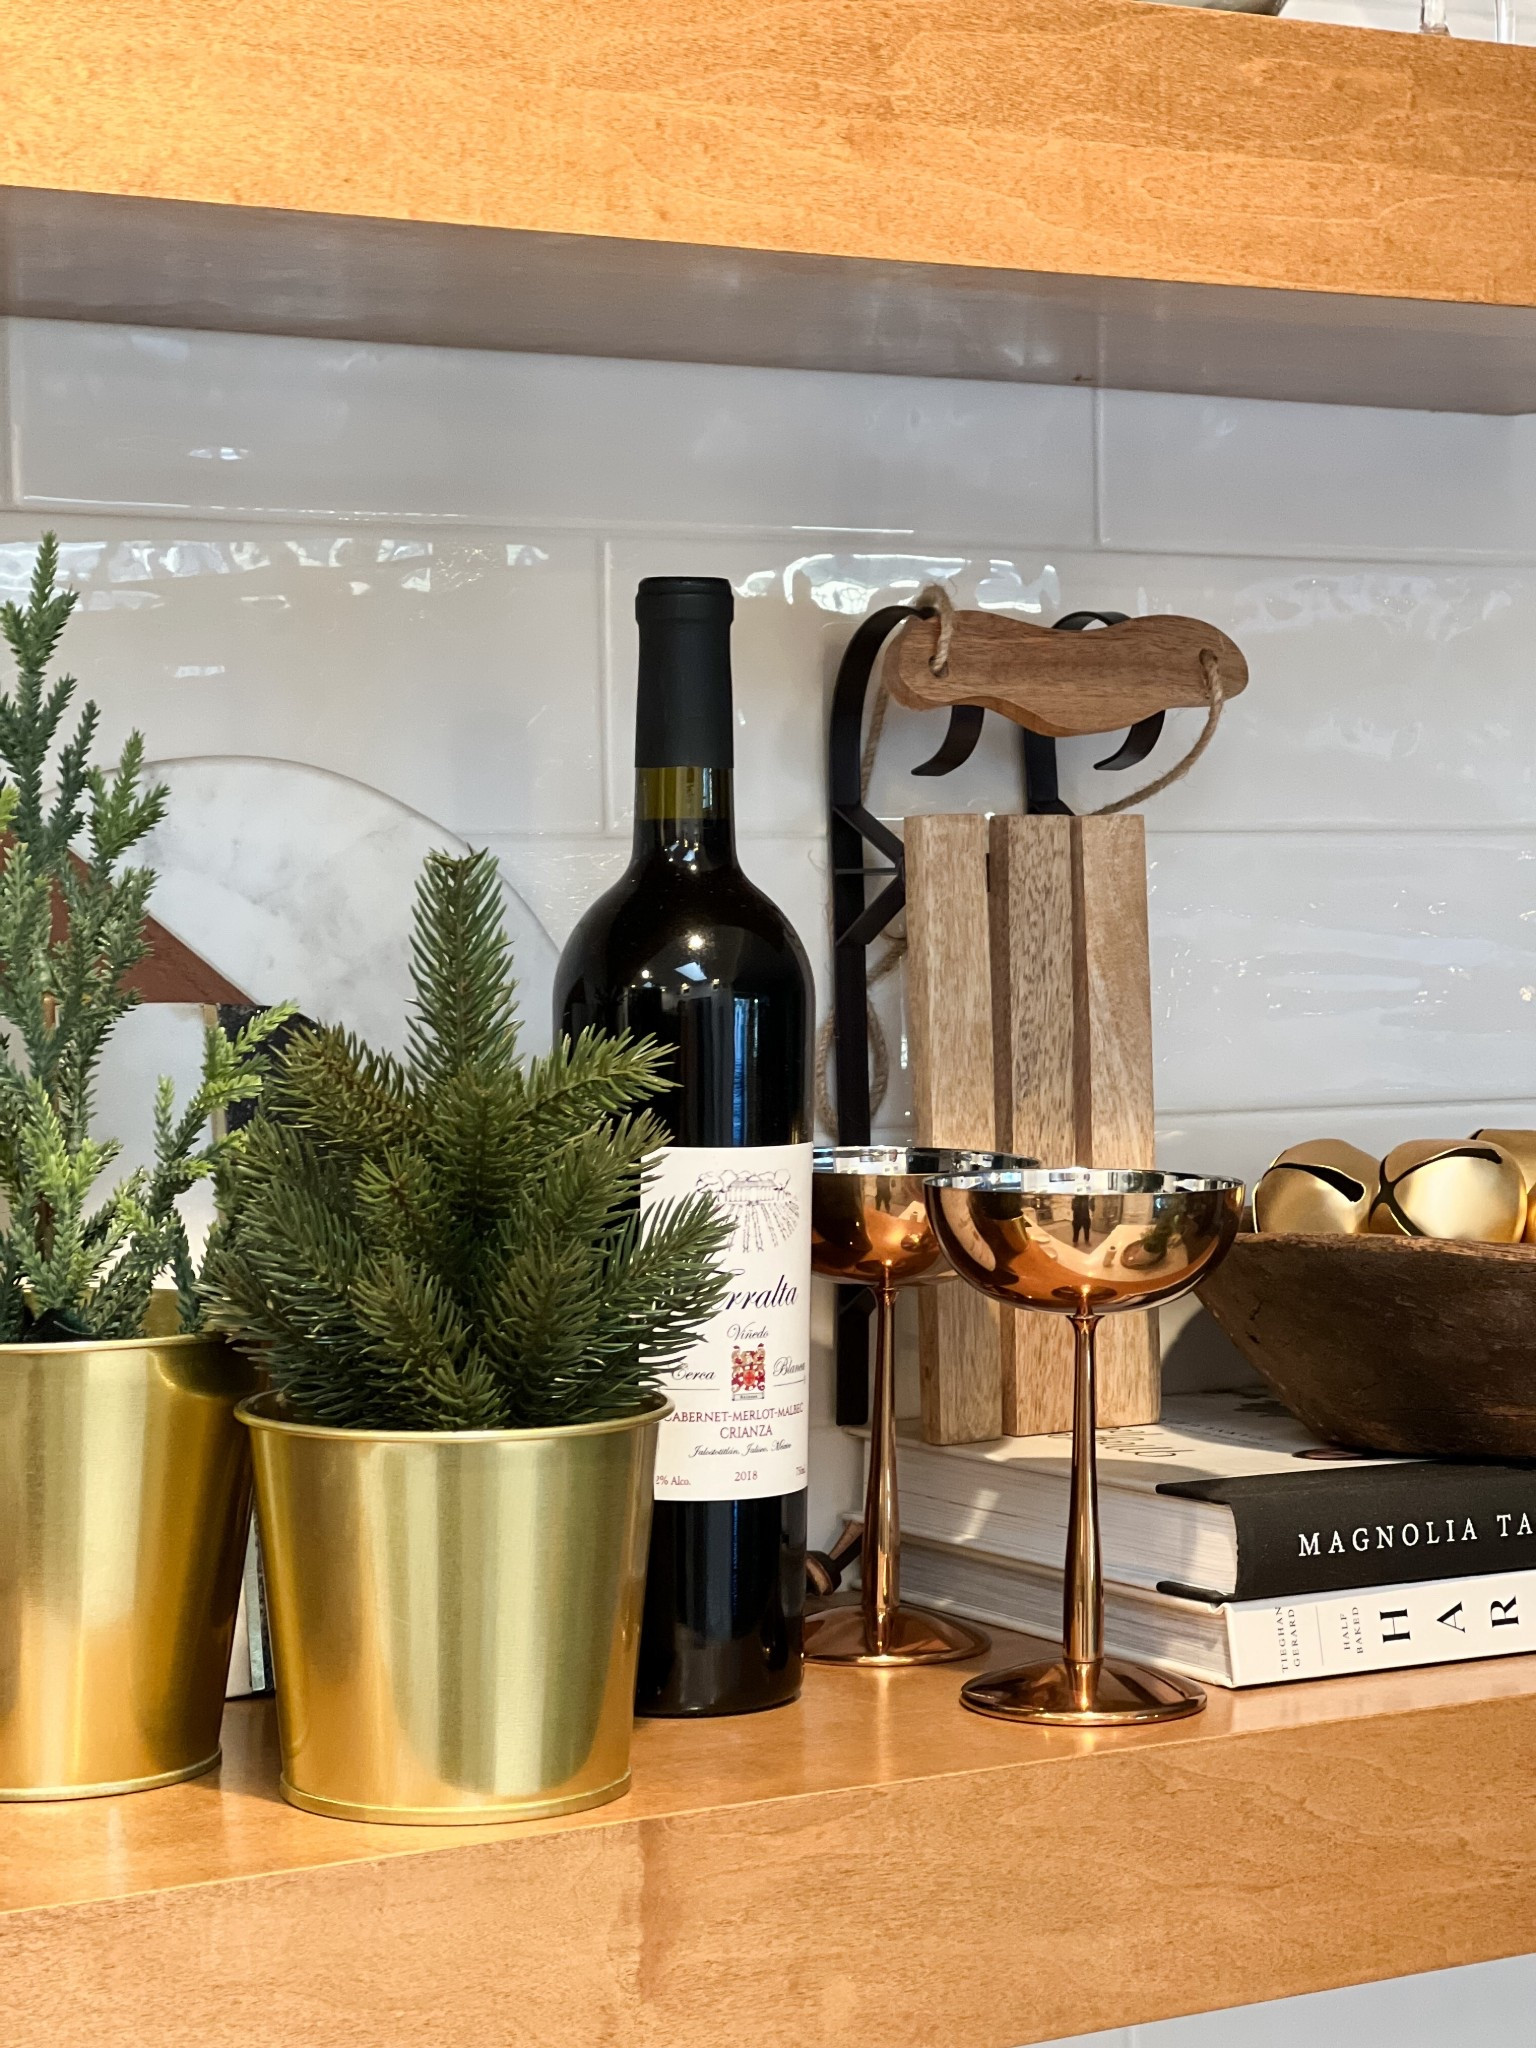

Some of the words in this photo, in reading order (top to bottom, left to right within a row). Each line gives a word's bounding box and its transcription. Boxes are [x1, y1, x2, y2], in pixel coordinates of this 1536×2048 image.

[710, 1269, 797, 1310] rralta
[727, 1321, 769, 1340] Viñedo
[720, 1425, 773, 1439] CRIANZA
[734, 1470, 758, 1482] 2018
[1298, 1518, 1478, 1557] MAGNOLIA
[1496, 1512, 1534, 1537] TA
[1275, 1606, 1289, 1674] TIEGHAN
[1288, 1609, 1301, 1667] GERARD
[1340, 1613, 1351, 1651] HALF
[1352, 1606, 1364, 1654] BAKED
